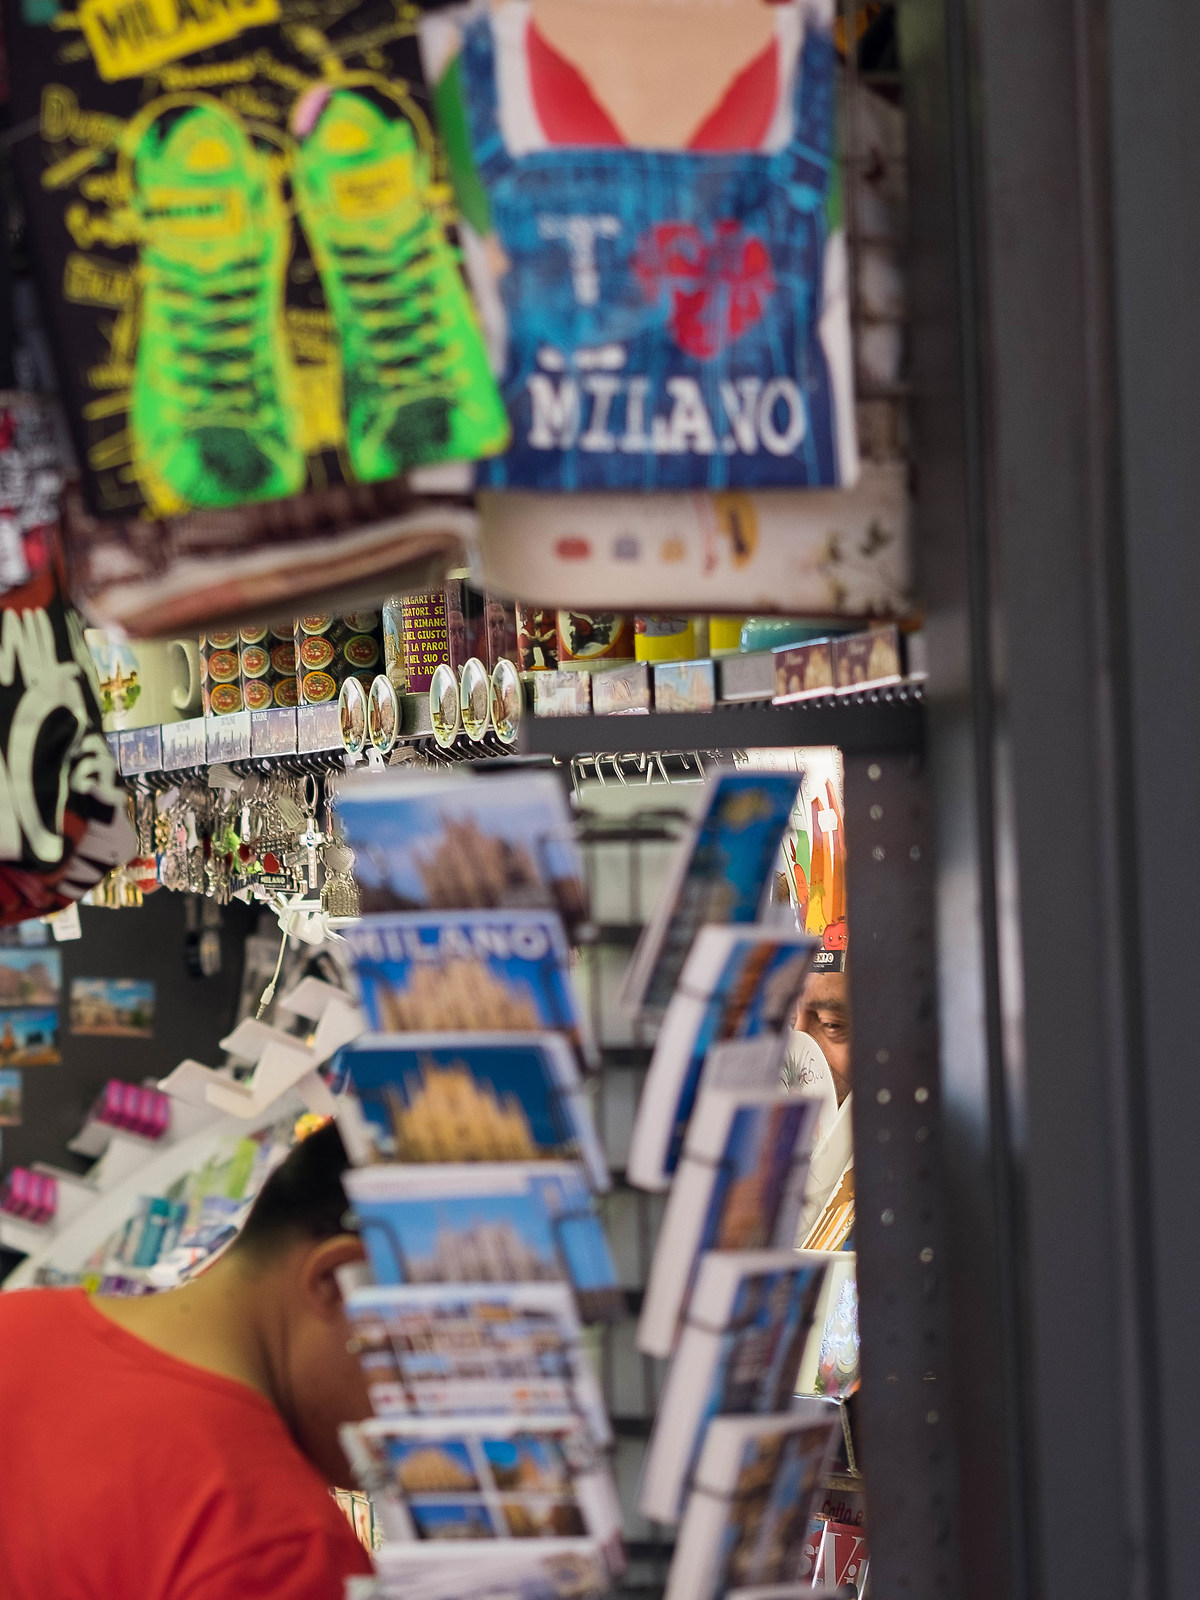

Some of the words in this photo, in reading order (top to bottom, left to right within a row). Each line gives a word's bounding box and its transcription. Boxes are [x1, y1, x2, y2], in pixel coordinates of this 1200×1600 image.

[526, 370, 812, 457] MILANO
[411, 642, 420, 652] LA
[423, 653, 438, 663] SUO
